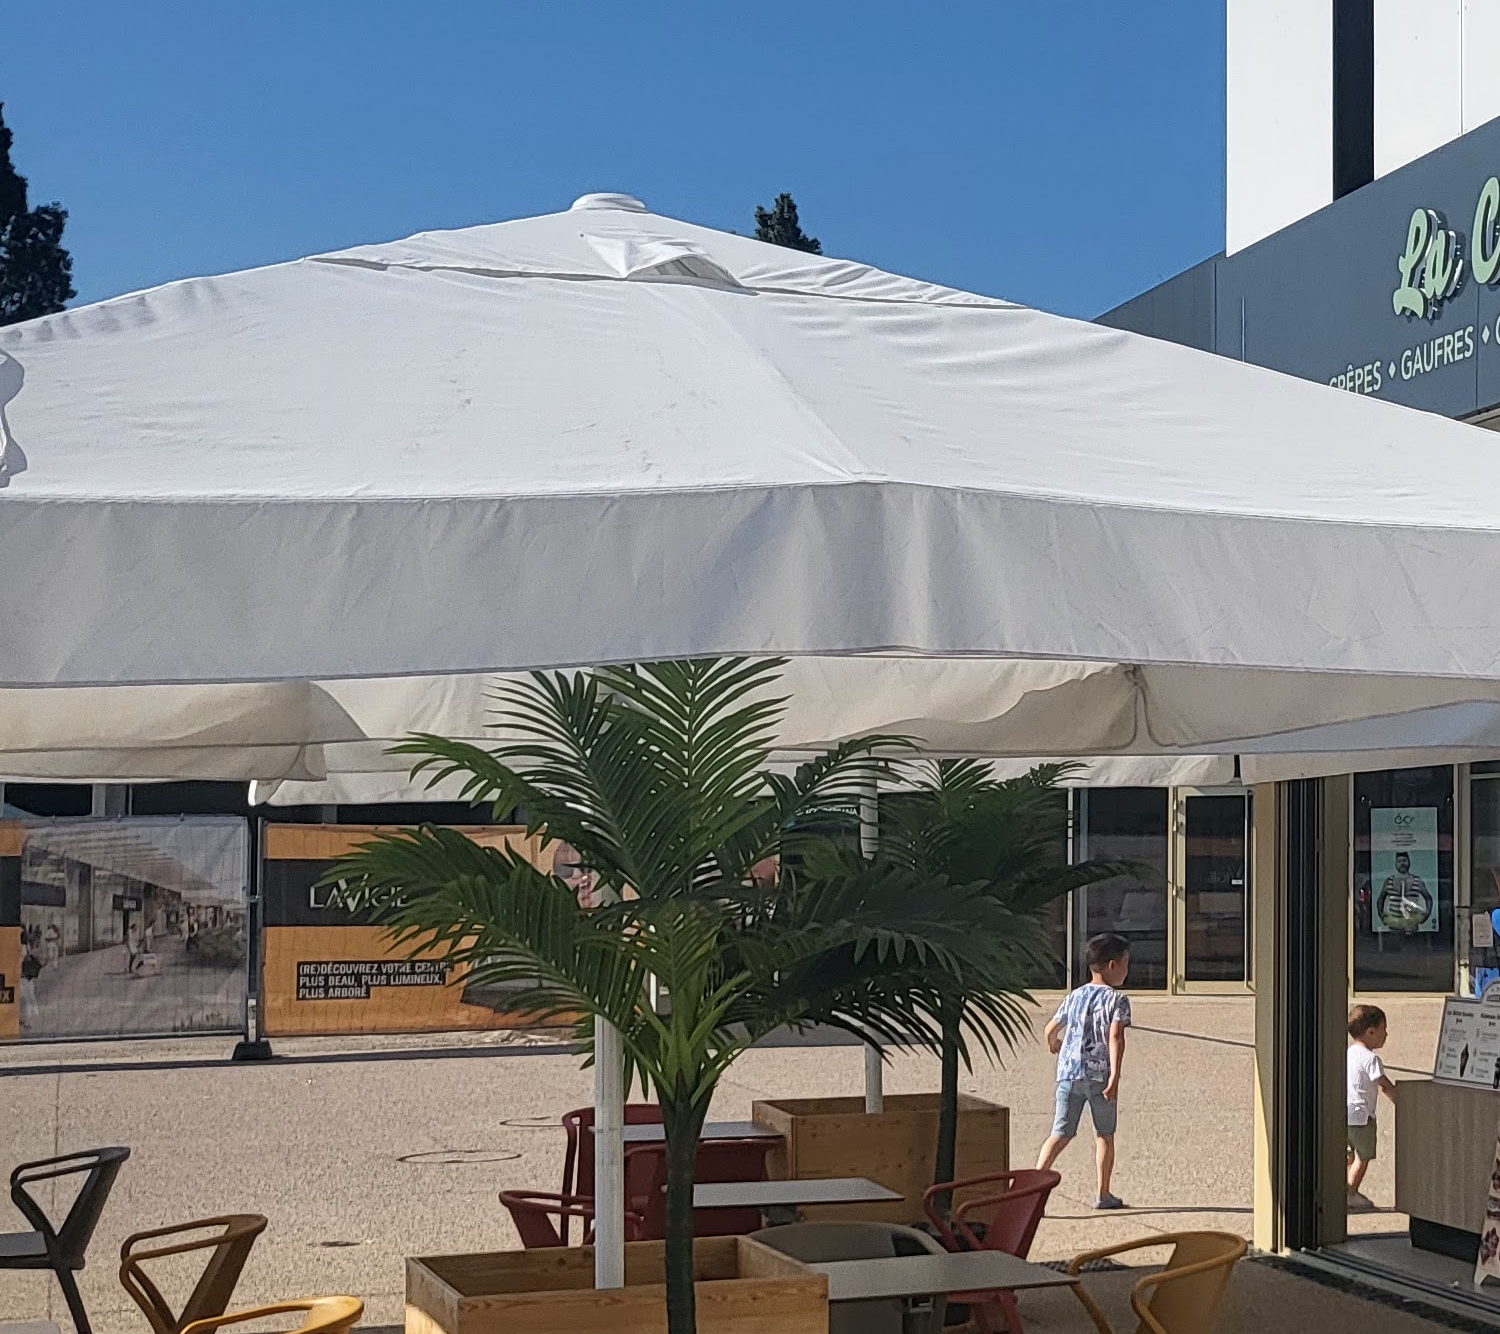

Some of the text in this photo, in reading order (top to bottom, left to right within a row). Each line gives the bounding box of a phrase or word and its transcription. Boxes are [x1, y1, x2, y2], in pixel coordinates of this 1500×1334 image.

[1392, 208, 1453, 316] La
[1400, 325, 1474, 380] GAUFRES
[299, 961, 452, 976] (RE)DÉCOUVREZ VOTRE CENTR
[299, 974, 444, 988] PLUS BEAU, PLUS LUMINEUX,
[299, 986, 368, 999] PLUS ARBORÉ
